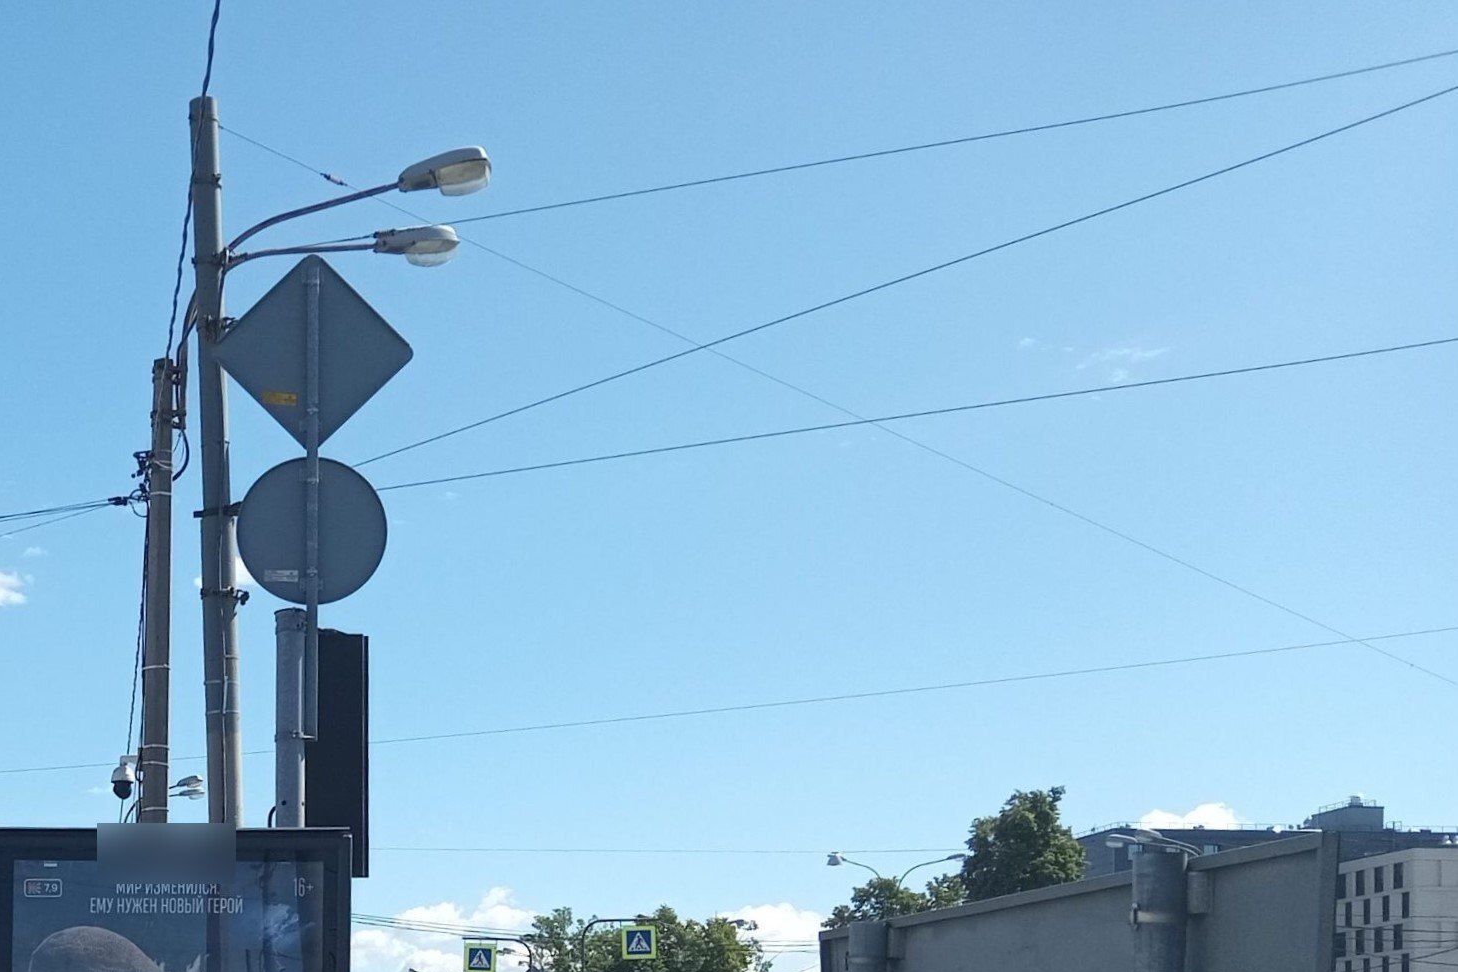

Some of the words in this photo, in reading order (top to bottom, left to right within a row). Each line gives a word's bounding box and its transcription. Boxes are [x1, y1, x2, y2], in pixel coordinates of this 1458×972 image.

[116, 883, 142, 895] МИР
[293, 877, 315, 898] 16+
[90, 897, 114, 914] ЕМУ
[117, 897, 157, 914] НУЖЕН
[161, 895, 203, 914] НОВЫЙ
[207, 895, 244, 914] ГЕРОЙ
